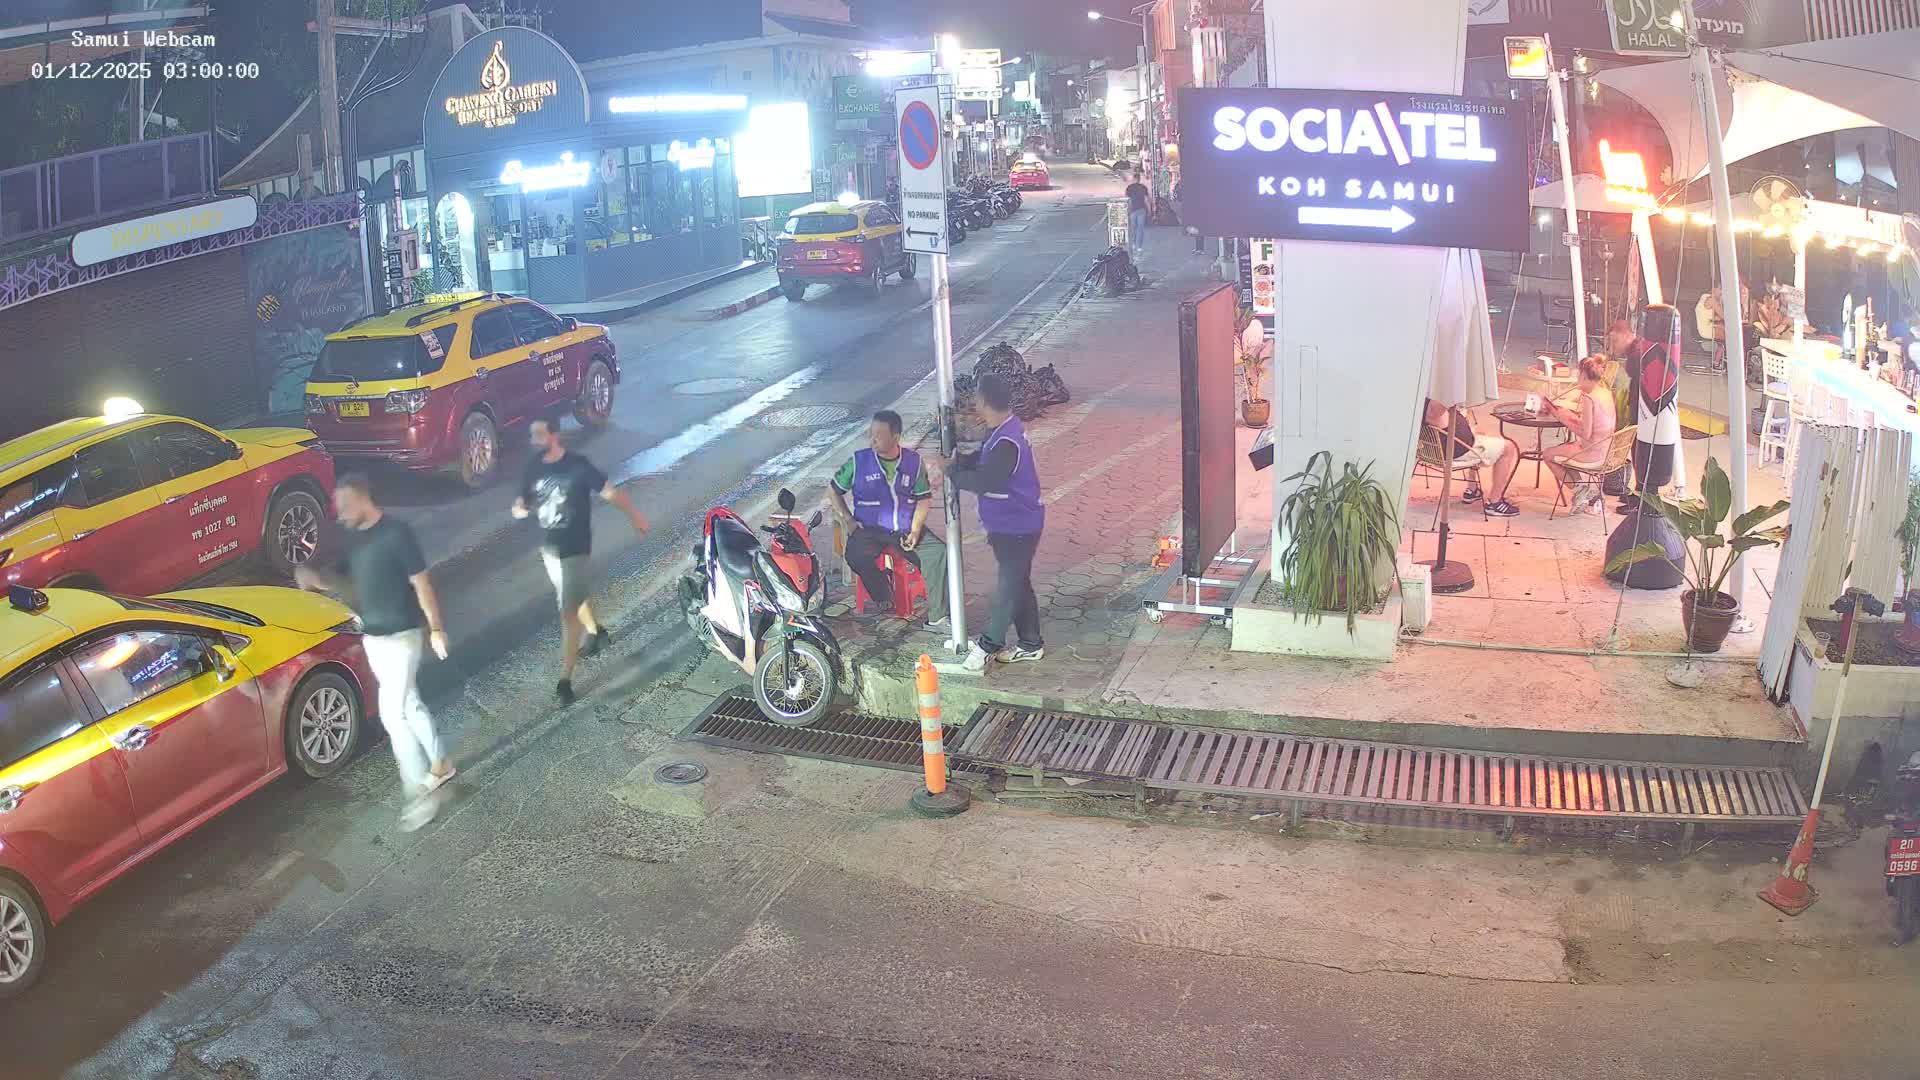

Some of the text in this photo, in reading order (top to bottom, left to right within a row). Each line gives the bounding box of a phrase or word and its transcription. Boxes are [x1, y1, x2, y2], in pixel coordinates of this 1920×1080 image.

[1628, 32, 1677, 47] HALAL
[838, 103, 880, 113] EXCHANGE
[1258, 176, 1455, 203] KOH SAMUI
[907, 210, 940, 220] NO PARKING
[112, 208, 224, 251] DISPENSARY
[204, 520, 222, 536] 1027
[1900, 839, 1913, 850] 2ก
[1890, 860, 1918, 872] 0596
